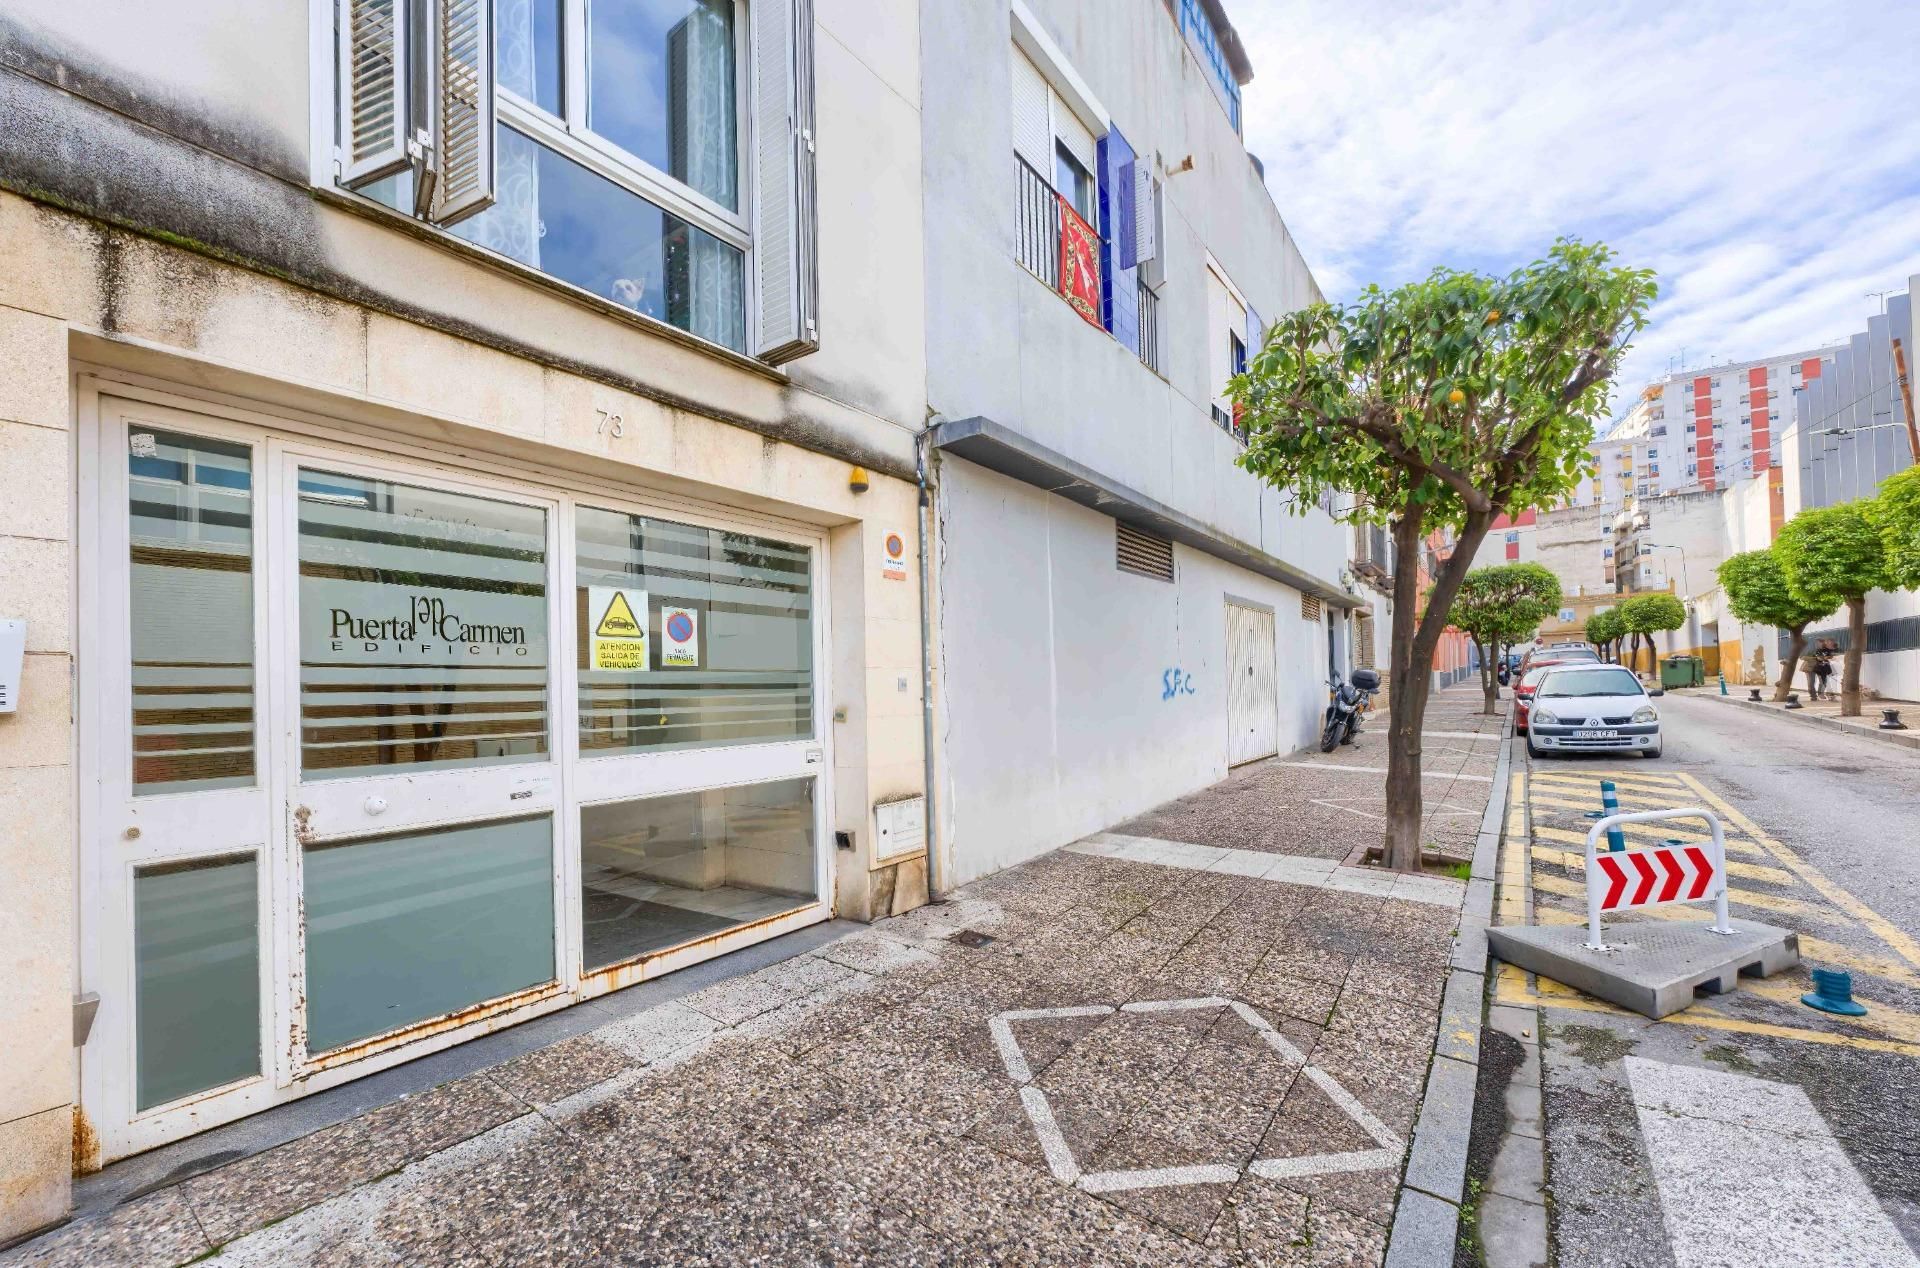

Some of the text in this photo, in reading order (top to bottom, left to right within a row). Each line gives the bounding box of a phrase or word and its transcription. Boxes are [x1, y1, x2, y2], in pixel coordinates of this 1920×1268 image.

[596, 408, 624, 439] 73
[329, 608, 414, 642] Puerta
[439, 614, 526, 645] Carmen
[331, 641, 528, 657] EDIFICIO
[600, 652, 640, 661] SALIDA DE
